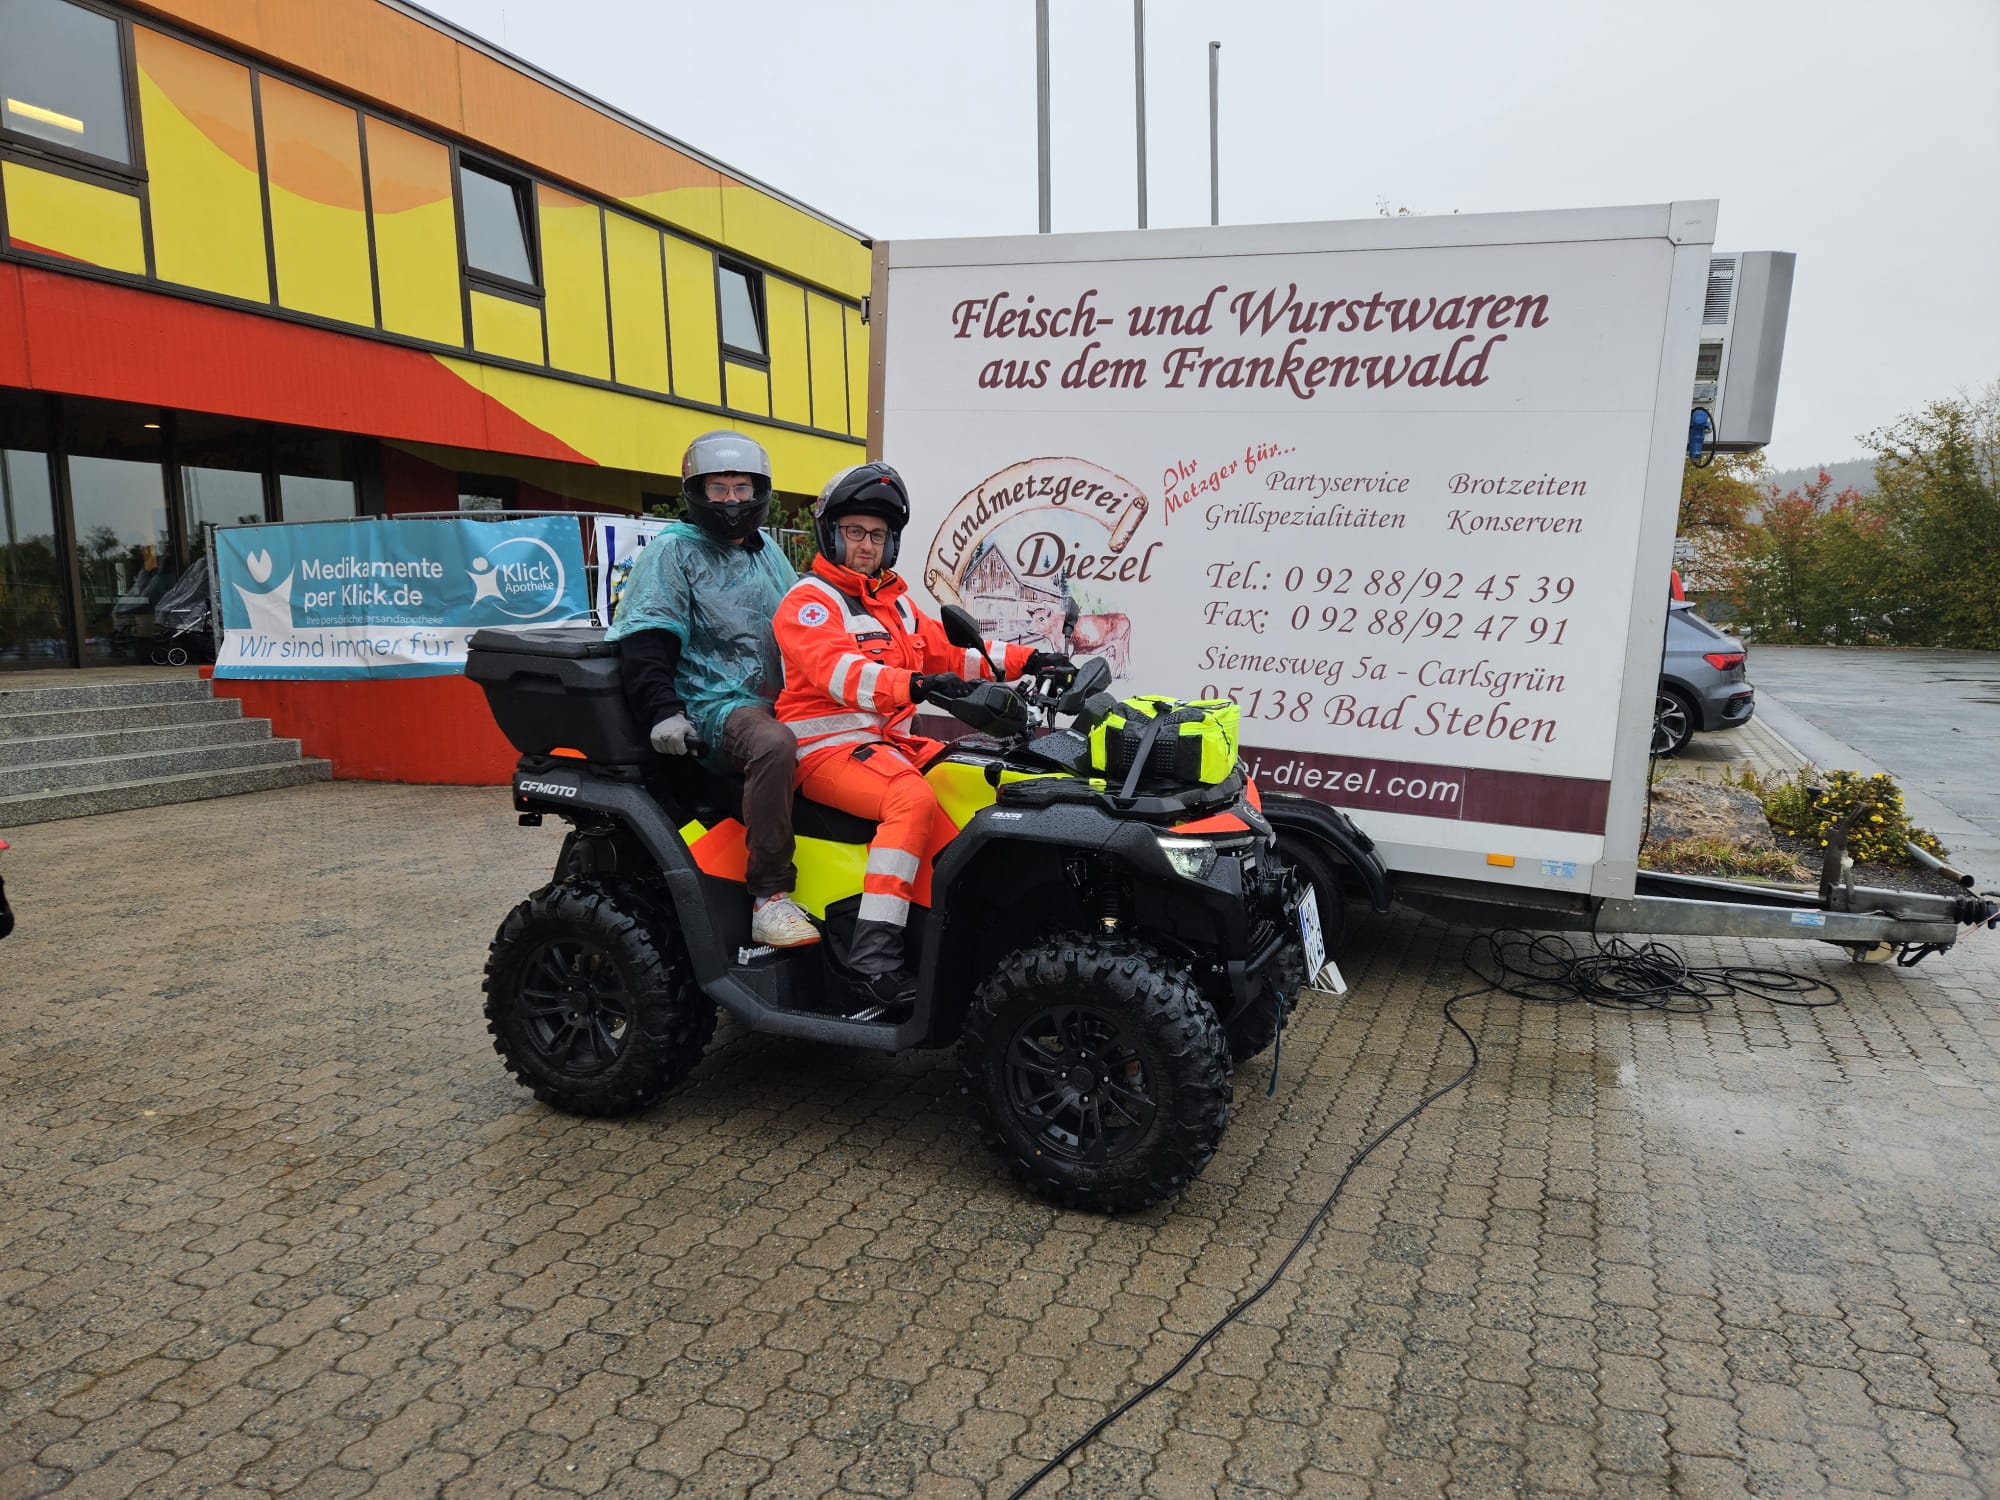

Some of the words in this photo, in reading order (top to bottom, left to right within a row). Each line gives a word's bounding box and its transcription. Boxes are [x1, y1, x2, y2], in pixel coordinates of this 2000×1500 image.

[952, 289, 1114, 338] Fleisch-
[1128, 285, 1228, 337] und
[1230, 283, 1549, 337] Wurstwaren
[978, 358, 1051, 389] aus
[1060, 342, 1148, 389] dem
[1163, 334, 1508, 400] Frankenwald
[1164, 459, 1239, 527] Metzger
[1265, 471, 1409, 500] Partyservice
[1448, 473, 1587, 497] Brotzeiten
[937, 474, 1129, 576] Landmetzgerei
[1205, 502, 1406, 533] Grillspezialitäten
[1447, 508, 1583, 536] Konserven
[301, 556, 444, 580] Medikamente
[503, 561, 551, 583] Klick
[1016, 531, 1164, 584] Diezel
[304, 590, 335, 612] per
[341, 584, 424, 606] Klick.de
[505, 581, 555, 594] Apotheke
[1206, 561, 1272, 590] Tel.:
[1285, 566, 1304, 592] 0
[1313, 567, 1353, 594] 92
[1364, 567, 1464, 604] 88/92
[1475, 574, 1521, 602] 45
[1529, 576, 1575, 604] 39
[1204, 601, 1269, 635] Fax:
[1291, 605, 1310, 631] 0
[1317, 606, 1358, 633] 92
[1367, 607, 1464, 644] 88/92
[1473, 614, 1519, 642] 47
[1524, 616, 1569, 645] 91
[240, 635, 277, 657] Wir
[280, 634, 323, 657] sind
[331, 634, 402, 657] immer
[410, 632, 454, 657] für
[1198, 646, 1345, 686] Siemesweg
[1352, 655, 1387, 680] 5a
[1417, 659, 1566, 698] Carlsgrün
[1323, 694, 1418, 731] Bad
[1414, 701, 1558, 744] Steben
[519, 780, 577, 798] CFMOTO
